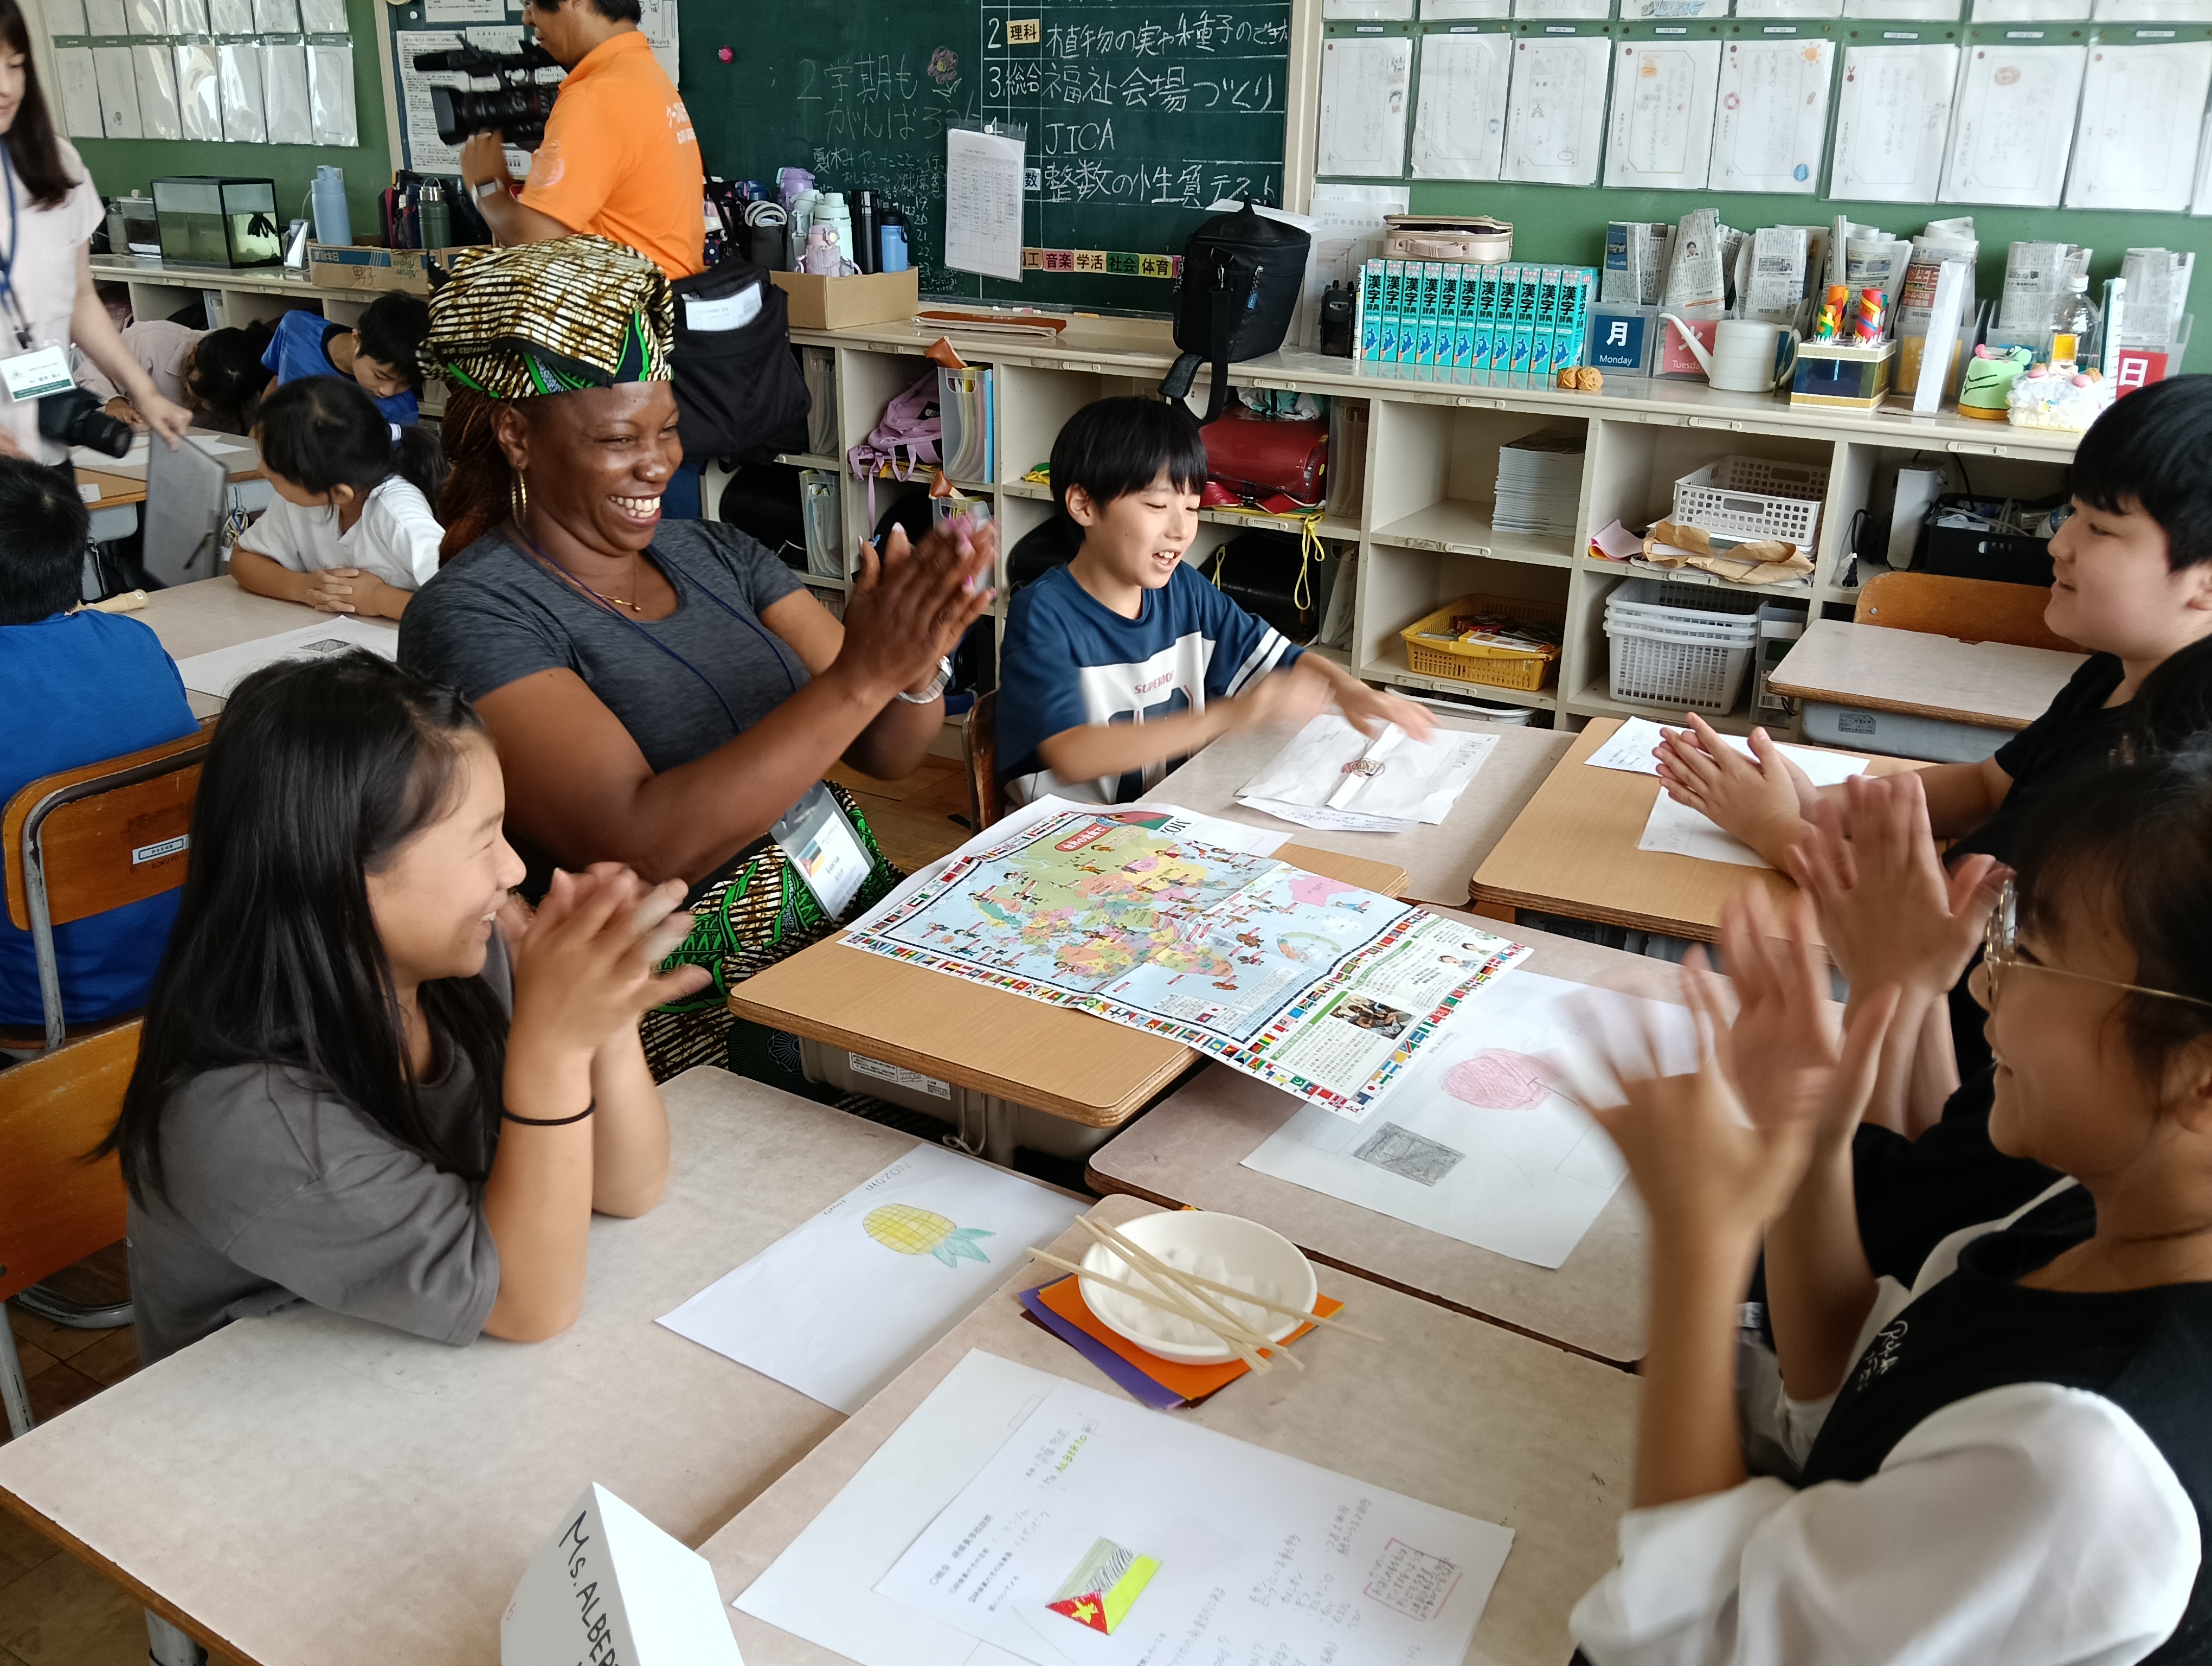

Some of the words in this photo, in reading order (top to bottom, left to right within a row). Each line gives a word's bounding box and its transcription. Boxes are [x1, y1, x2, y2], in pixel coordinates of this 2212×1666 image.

[988, 18, 1001, 49] 2
[1010, 22, 1038, 41] 理科
[796, 53, 918, 104] 2学期も
[1043, 62, 1273, 113] 福祉会場づくり
[1045, 118, 1115, 155] JICA
[1045, 252, 1073, 269] 音楽
[1077, 252, 1103, 271] 学活
[1108, 256, 1136, 274] 社会
[1141, 257, 1169, 275] 体育
[352, 266, 376, 285] 男子
[1367, 275, 1381, 303] 漢字
[1386, 275, 1400, 304] 漢字
[1405, 277, 1419, 306] 漢字
[1424, 278, 1438, 306] 漢字
[1442, 279, 1457, 307] 漢字
[1461, 280, 1476, 309] 漢字
[1481, 281, 1496, 310] 漢字
[1500, 283, 1516, 311] 漢字
[1520, 284, 1536, 312] 漢字
[1540, 284, 1556, 313] 漢字
[1560, 286, 1577, 315] 漢字
[1606, 321, 1628, 347] 月
[1599, 354, 1632, 368] Monday
[2119, 357, 2148, 387] 日
[151, 855, 179, 869] KOKUYO
